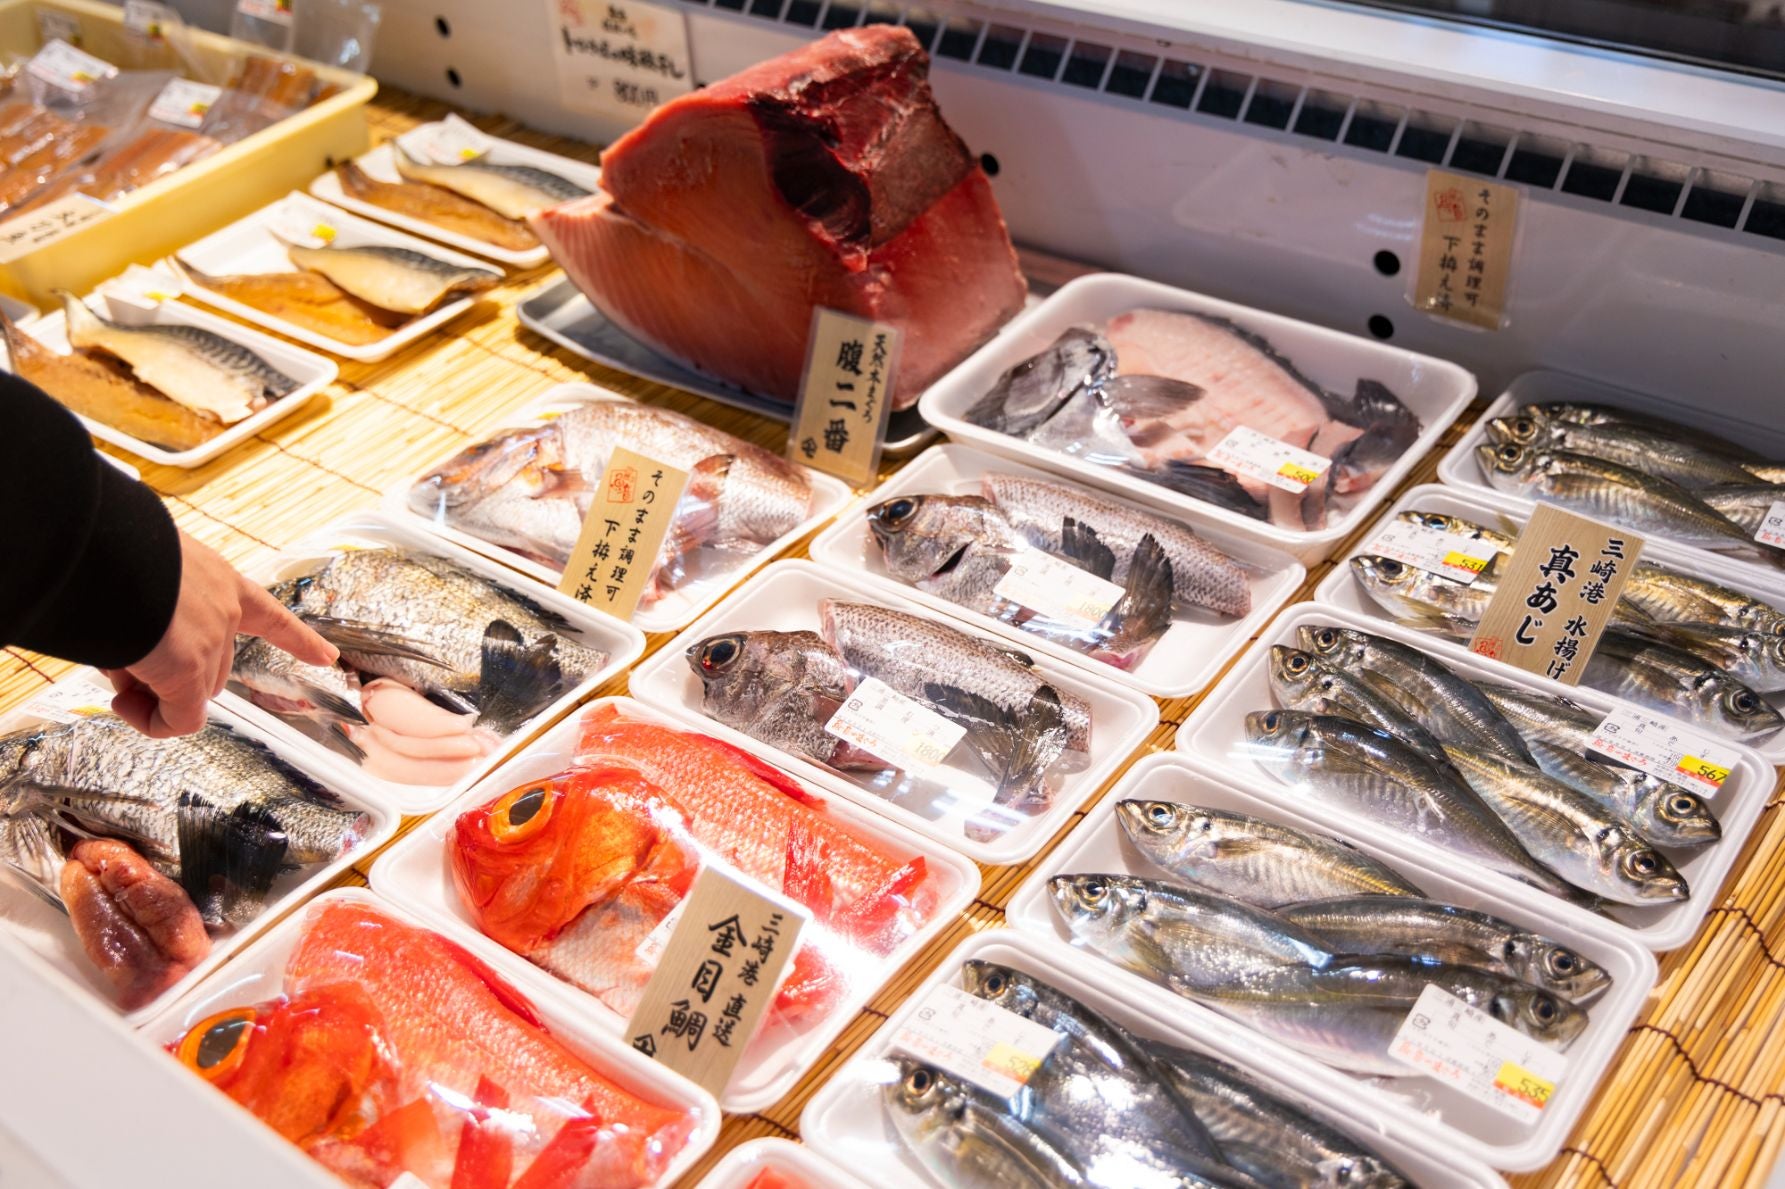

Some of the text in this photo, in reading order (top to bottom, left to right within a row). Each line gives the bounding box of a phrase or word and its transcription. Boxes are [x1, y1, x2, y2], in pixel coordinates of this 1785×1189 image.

[1464, 188, 1491, 306] そのまま調理可
[824, 339, 864, 454] 腹二番
[862, 333, 887, 424] 天然本まぐろ
[606, 470, 664, 602] そのまま調理可
[1515, 544, 1580, 645] 真あじ
[1546, 538, 1624, 680] 三崎港 水揚げ
[1697, 764, 1729, 783] 567
[661, 913, 748, 1052] 金目鯛
[712, 912, 783, 1048] 三崎港 直送
[1518, 1078, 1551, 1101] 535
